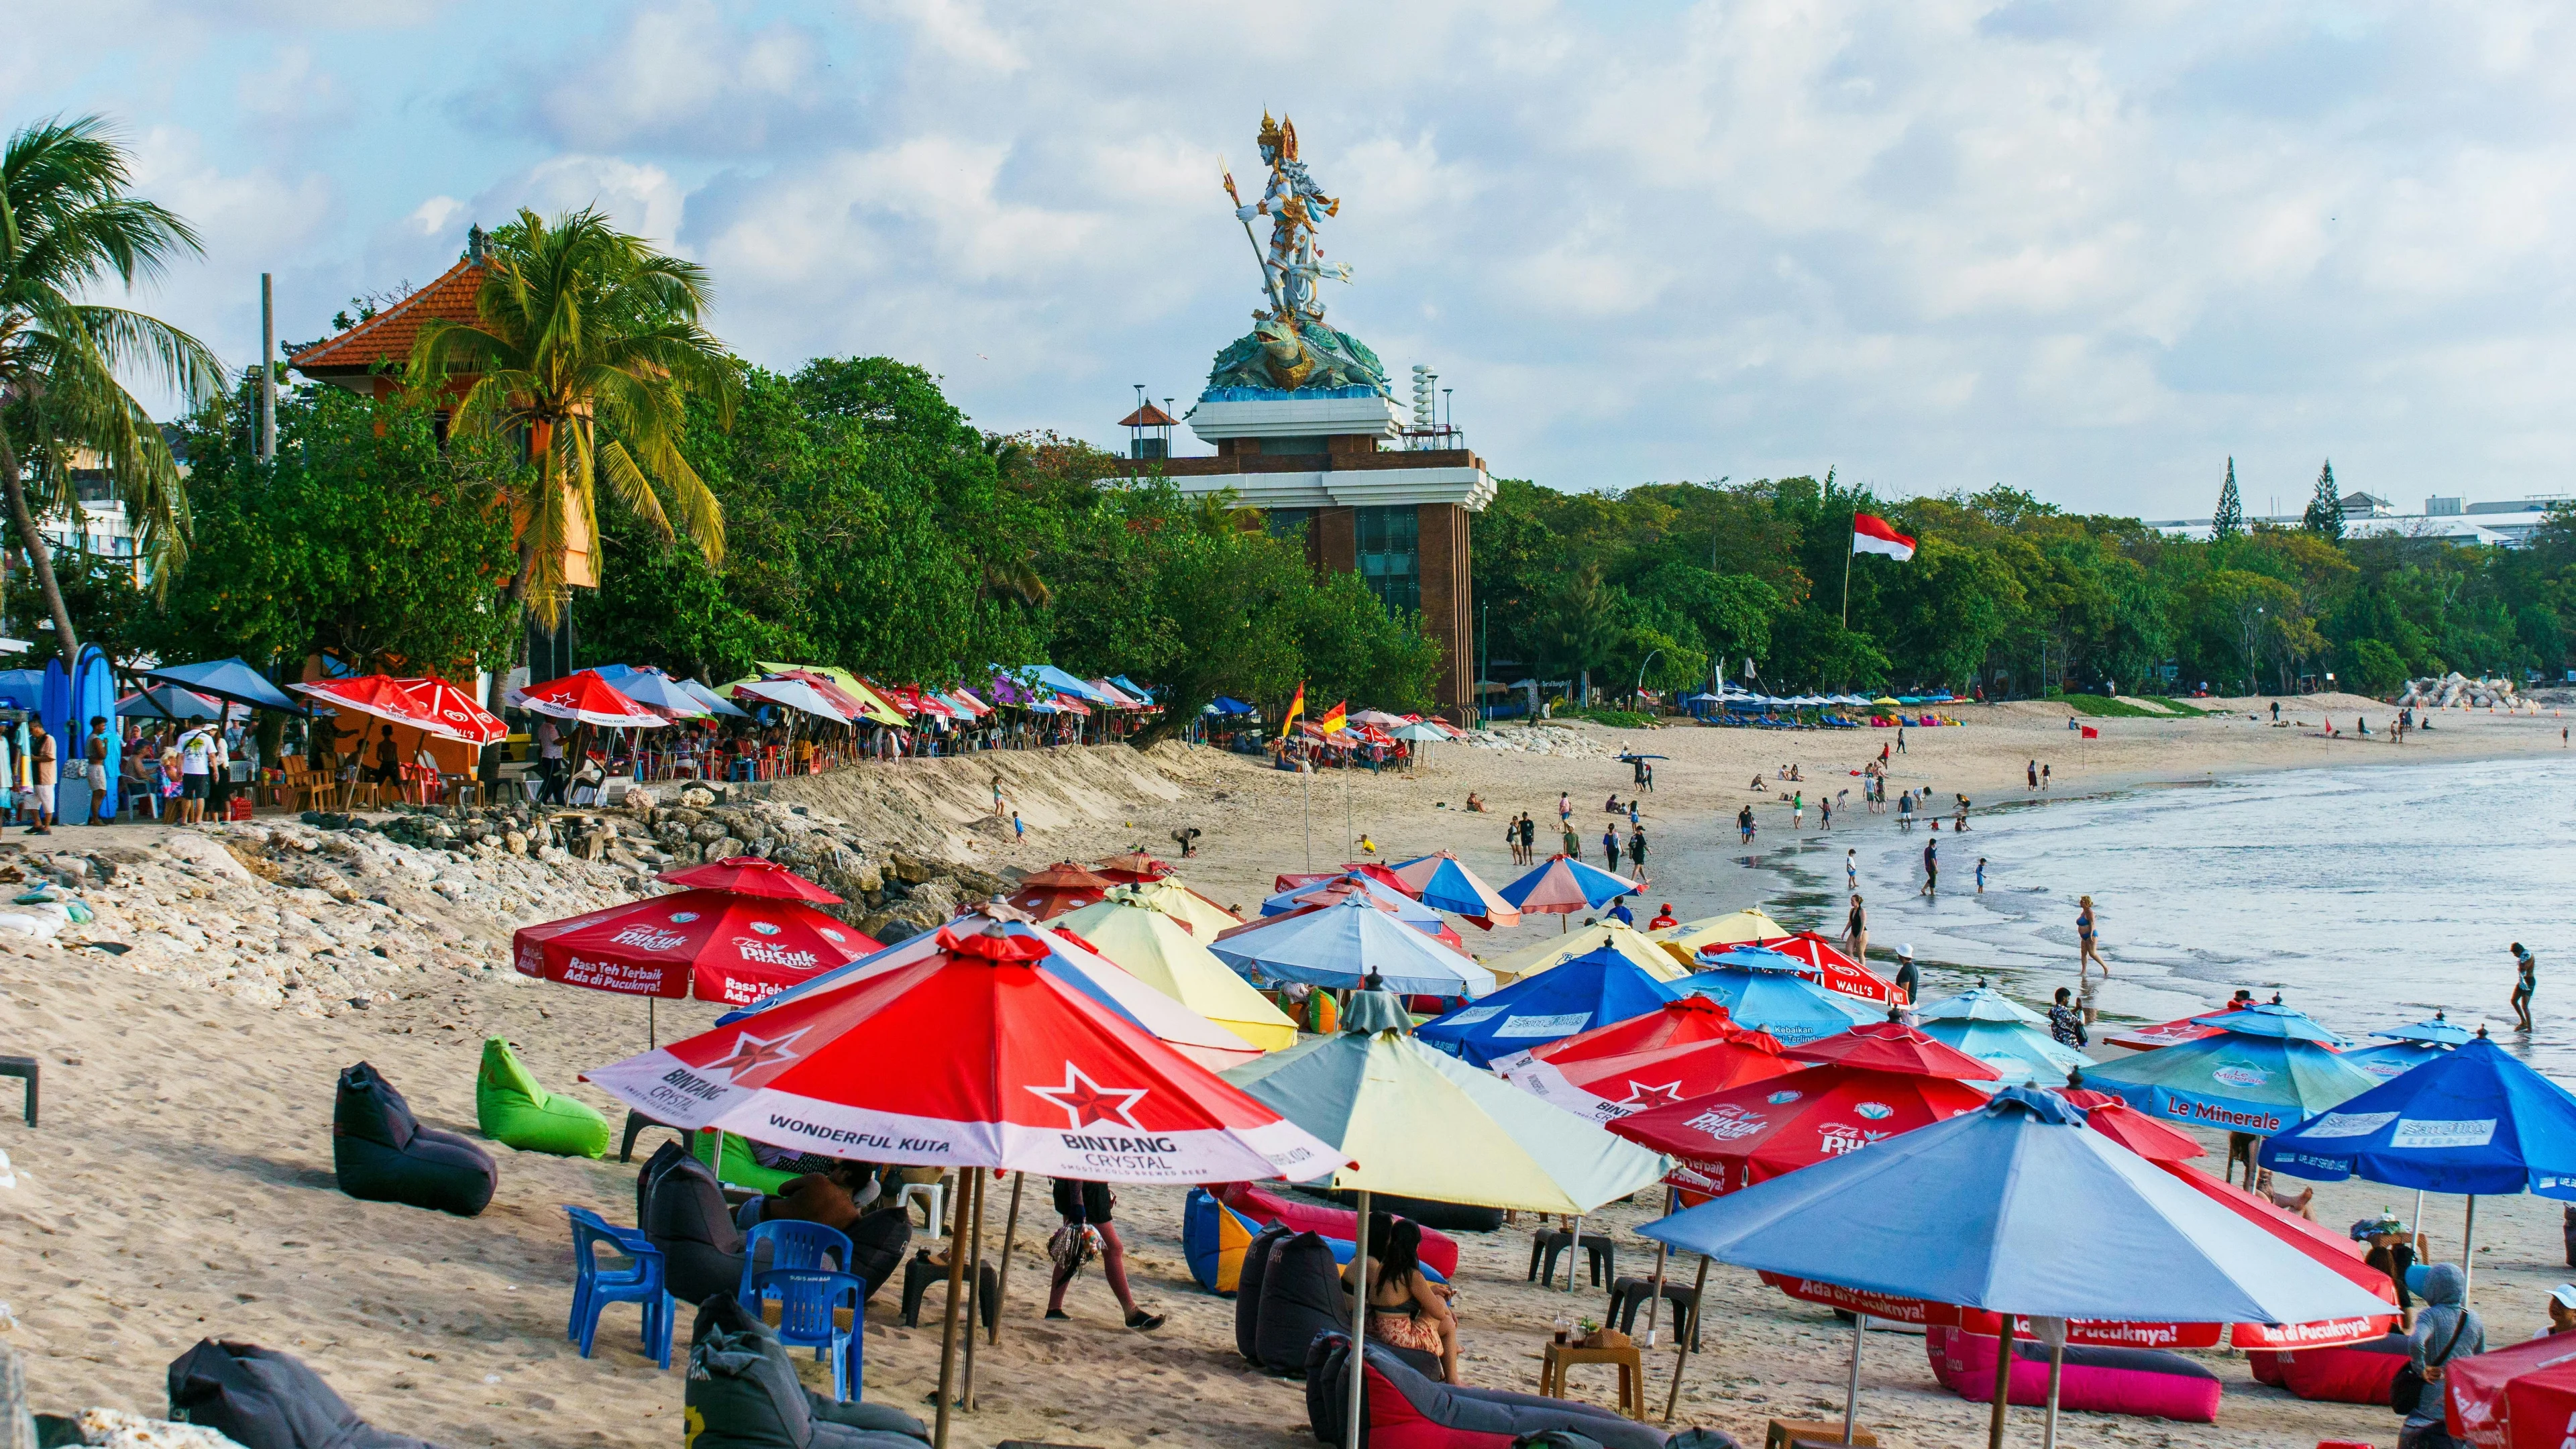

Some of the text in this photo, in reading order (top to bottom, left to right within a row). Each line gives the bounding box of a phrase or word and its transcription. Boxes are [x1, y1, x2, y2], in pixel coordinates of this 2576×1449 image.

[542, 702, 568, 712] BINTANG
[569, 957, 663, 981] Rasa Teh Terbaik
[755, 956, 818, 970] HARUM
[564, 969, 661, 994] Ada di Pucuknya!
[725, 977, 757, 993] Rasa
[1836, 979, 1873, 997] WALL'S
[724, 989, 751, 1004] Ada
[1892, 991, 1903, 1004] WALL'S
[1774, 1025, 1813, 1034] Kebaikan
[661, 1068, 729, 1101] BINTANG
[2214, 1071, 2267, 1085] Minerale
[649, 1085, 698, 1112] CRYSTAL
[1595, 1101, 1635, 1118] BINT
[2167, 1095, 2281, 1131] Le Minerale
[769, 1114, 951, 1152] WONDERFUL KUTA
[2406, 1136, 2479, 1145] LIGHT
[1061, 1134, 1177, 1153] BINTANG
[1061, 1163, 1102, 1173] SMOOTH
[1105, 1168, 1130, 1176] COLD
[1085, 1153, 1173, 1170] CRYSTAL
[1799, 1279, 1831, 1299] Ada
[2072, 1324, 2178, 1347] Pucuknya!
[2261, 1316, 2371, 1342] Ada di Pucuknya!
